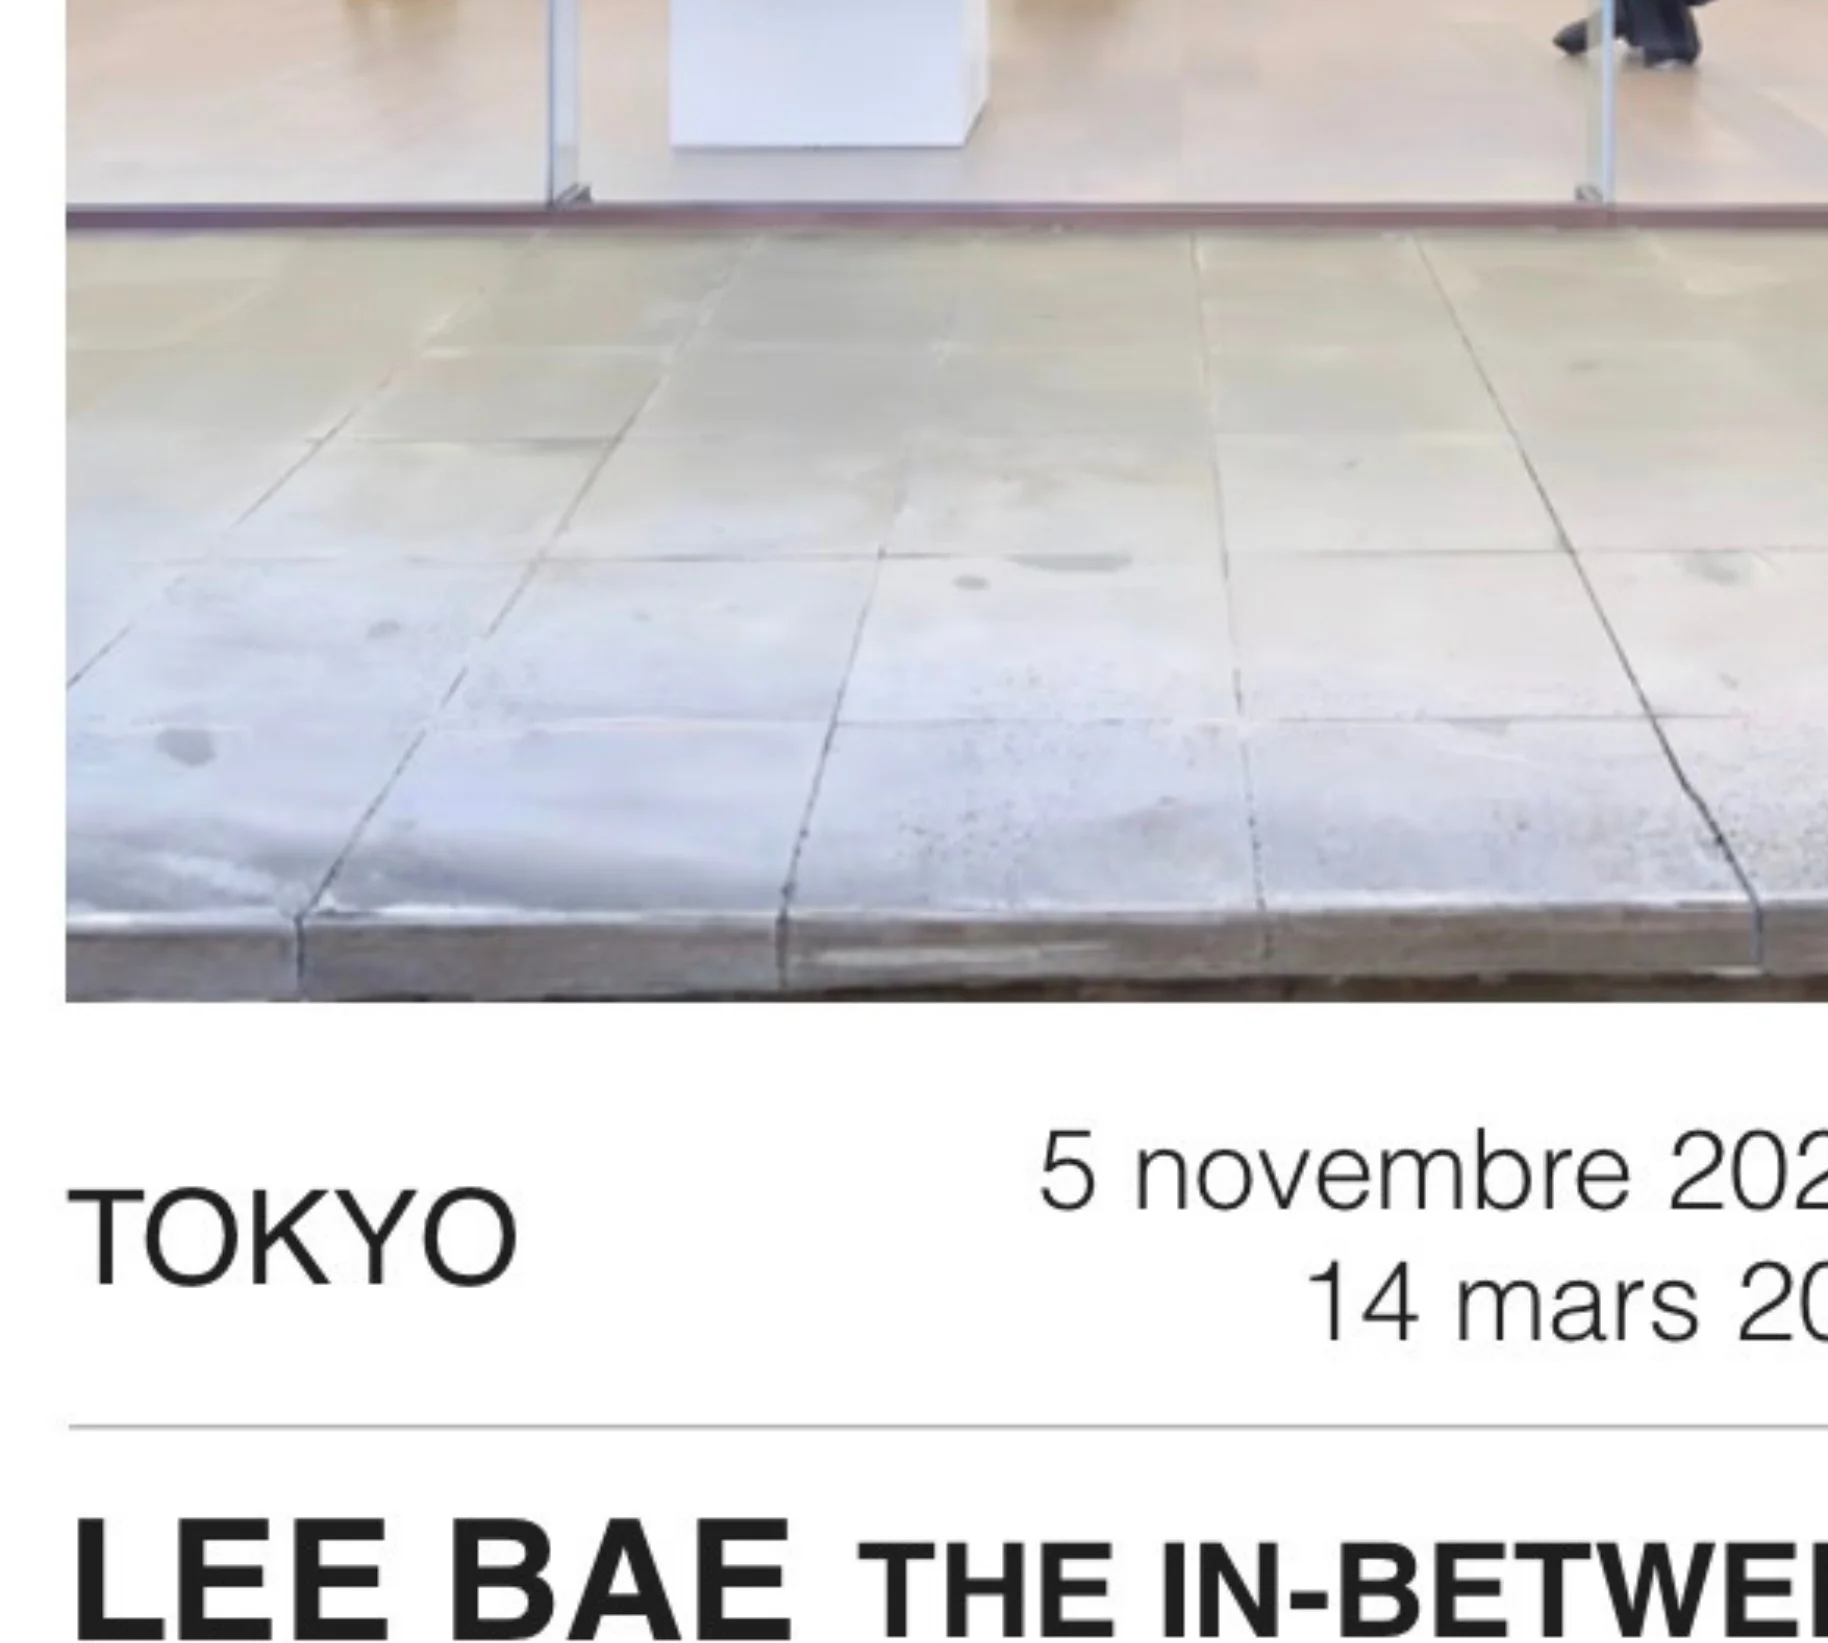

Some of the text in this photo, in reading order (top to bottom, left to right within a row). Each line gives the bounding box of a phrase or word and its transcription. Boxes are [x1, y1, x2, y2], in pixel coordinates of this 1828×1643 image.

[1040, 1129, 1095, 1212] 5
[1137, 1127, 1631, 1212] novembre
[66, 1186, 517, 1288] TOKYO
[1309, 1259, 1419, 1341] 14
[1458, 1279, 1699, 1344] mars
[77, 1517, 792, 1641] LEE BAE
[856, 1541, 1115, 1638] THE
